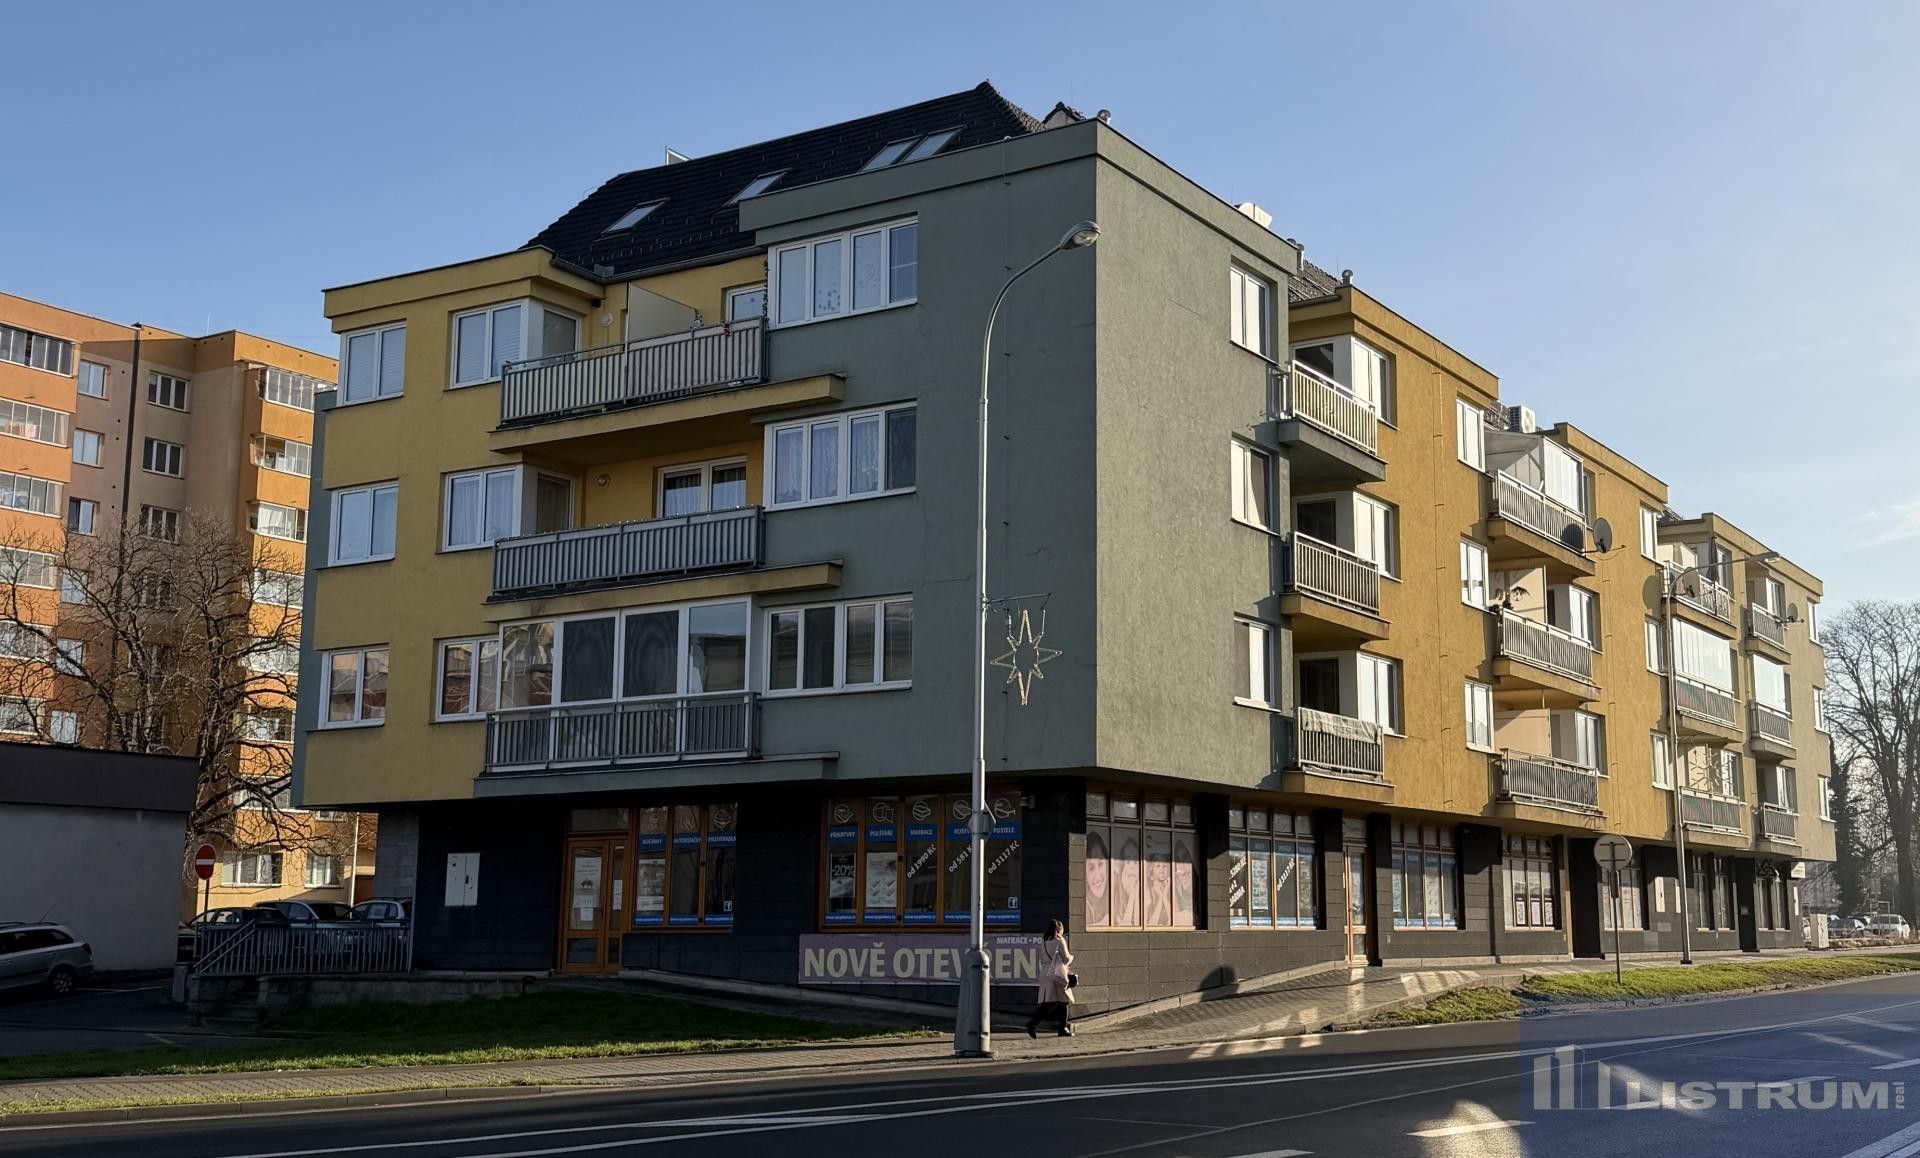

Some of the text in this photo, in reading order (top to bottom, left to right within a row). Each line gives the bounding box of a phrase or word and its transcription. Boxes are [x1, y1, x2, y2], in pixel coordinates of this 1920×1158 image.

[906, 867, 916, 878] od
[914, 852, 929, 870] 1990
[948, 859, 958, 873] od
[987, 861, 997, 874] od
[996, 936, 1028, 945] MATRACE
[804, 941, 1041, 979] NOVĚ OTEVEN
